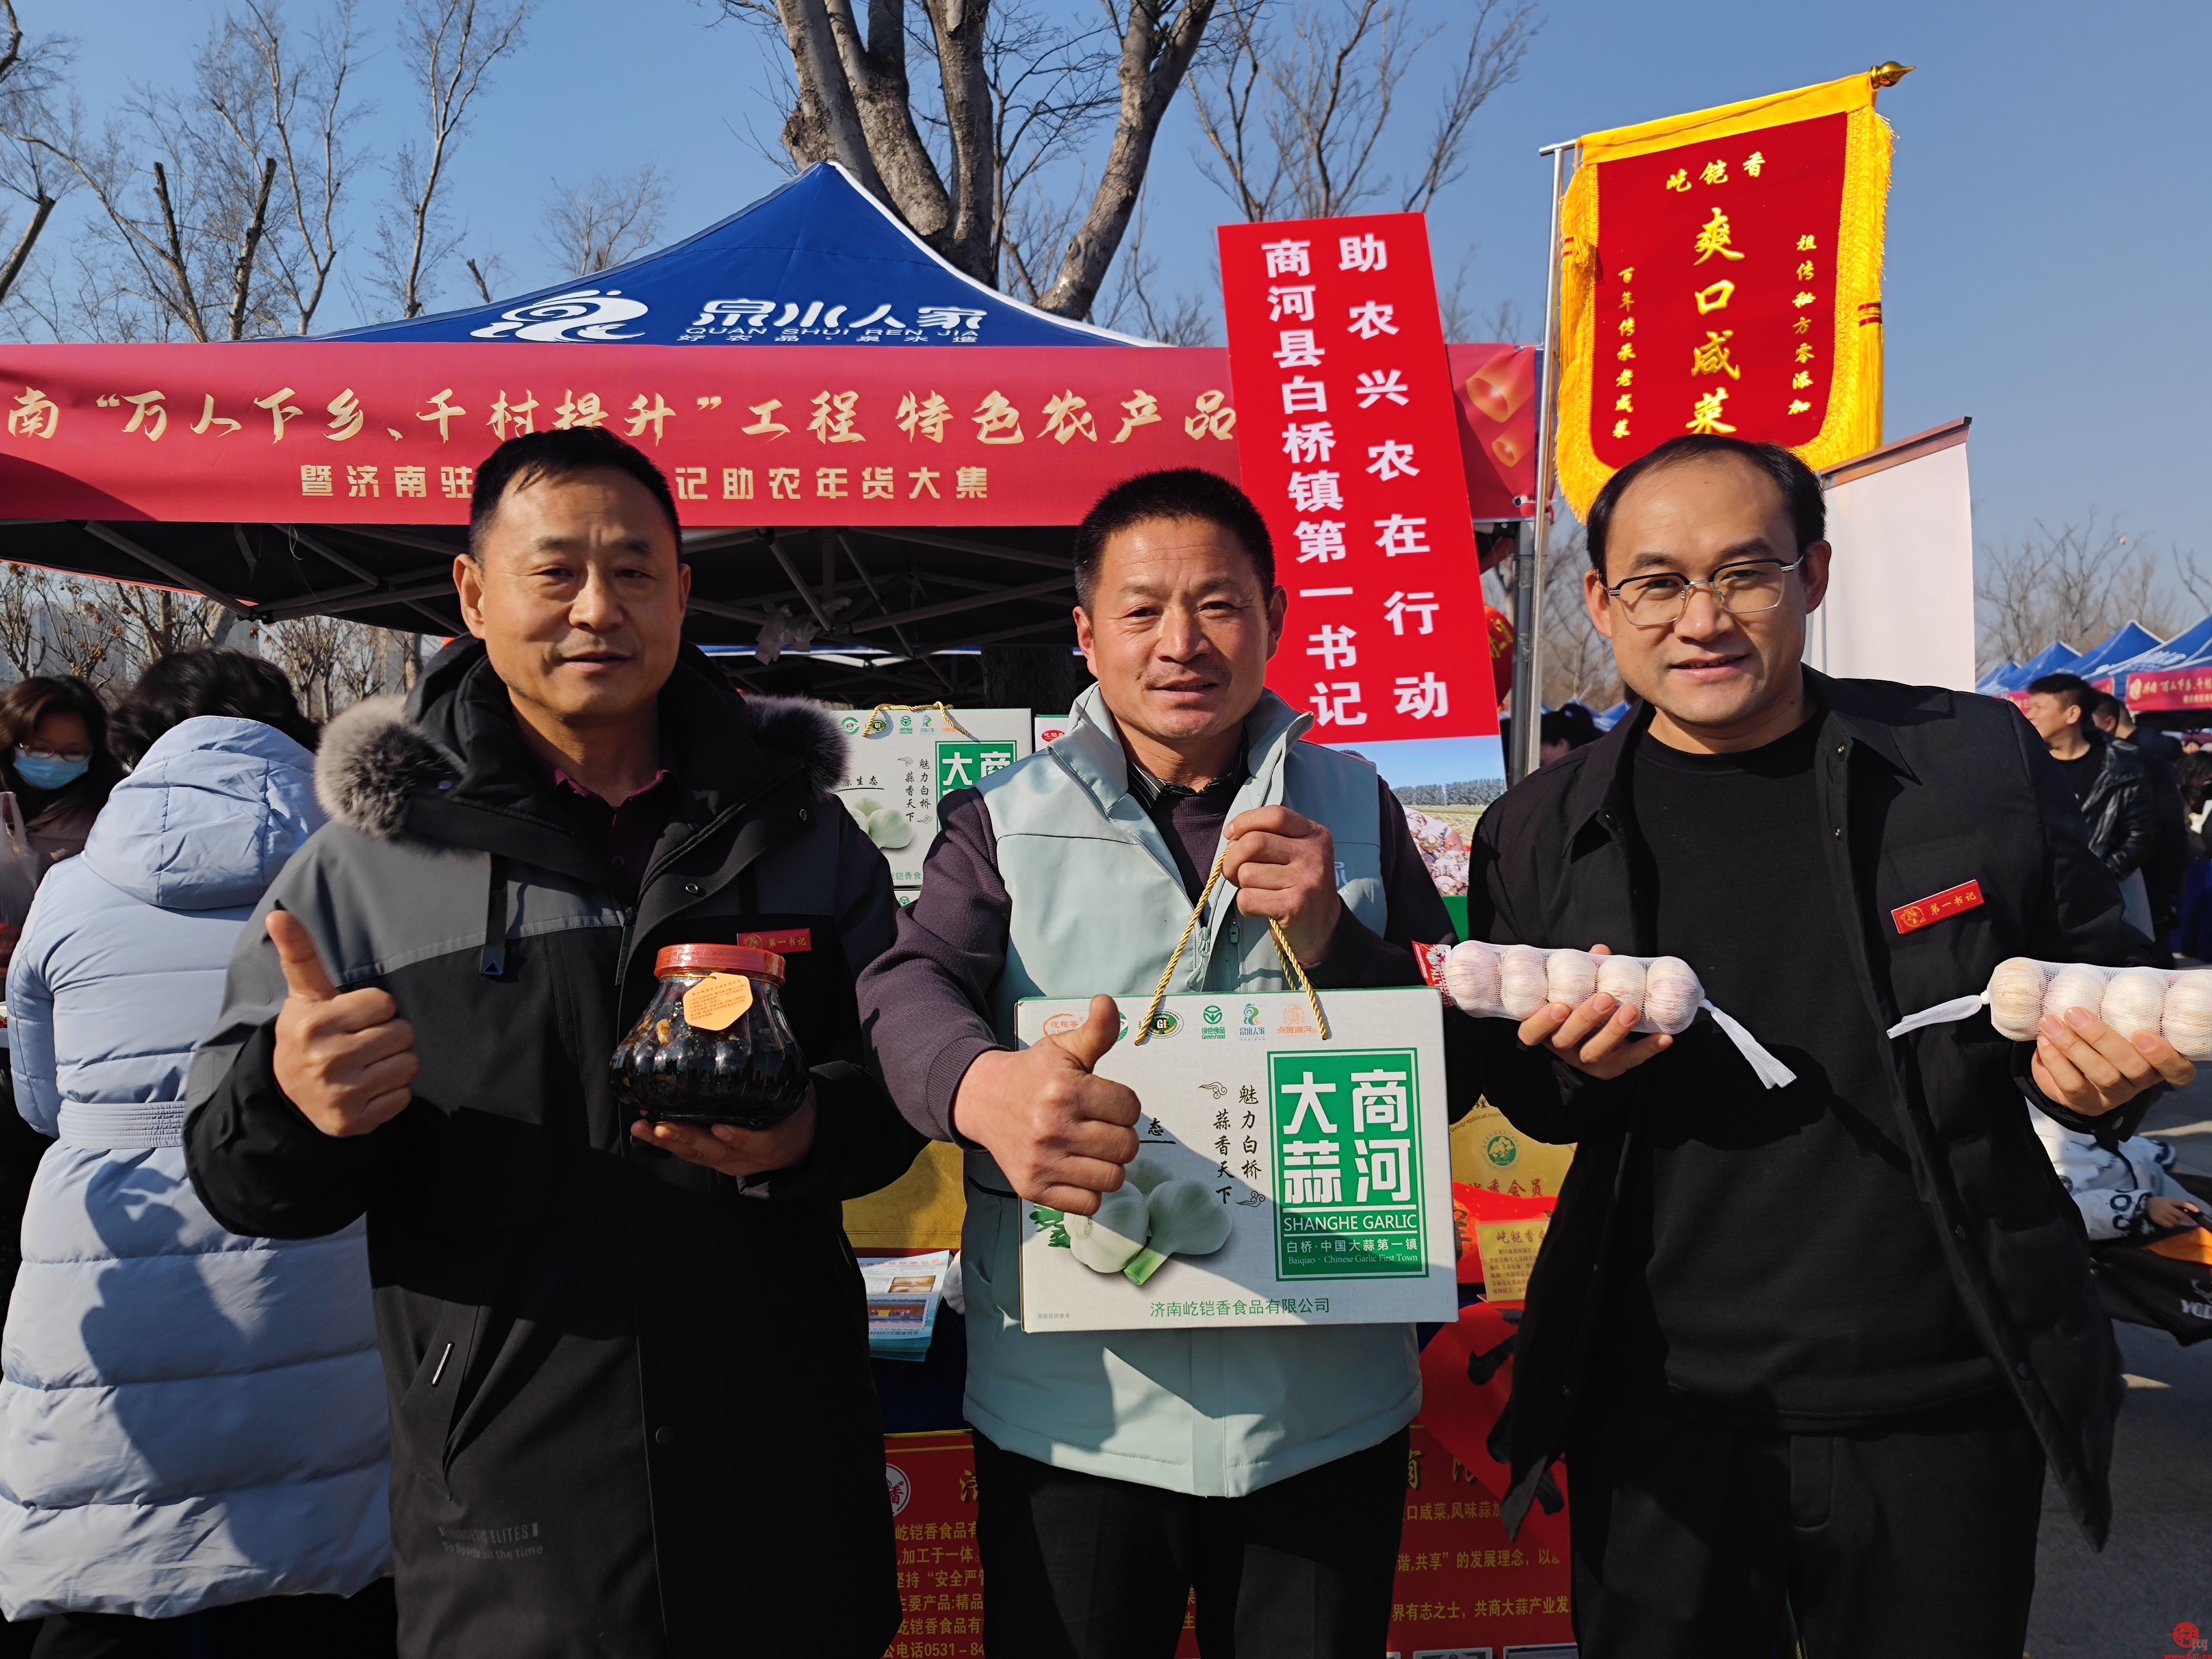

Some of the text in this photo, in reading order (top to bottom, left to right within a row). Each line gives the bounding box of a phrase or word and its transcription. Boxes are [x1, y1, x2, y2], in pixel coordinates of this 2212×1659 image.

[1666, 151, 1766, 193] 屹铠香
[692, 299, 987, 328] 泉水人家
[1789, 234, 1817, 415] 祖传秘方零添加
[782, 328, 849, 336] SHUI
[865, 329, 923, 337] REN
[937, 329, 979, 337] JIA
[1262, 240, 1367, 727] 商河县白桥镇第一书记
[1339, 233, 1449, 720] 助农兴农在行动
[905, 772, 916, 822] 蒜香天下
[919, 759, 931, 809] 魅力白桥
[1930, 892, 1977, 916] 第一书记
[768, 936, 807, 949] 第一书记
[1239, 1027, 1265, 1036] 泉水人家
[1238, 1084, 1262, 1181] 魅力白桥
[1450, 1112, 1487, 1133] Geographical
[1212, 1110, 1233, 1205] 蒜香天下
[1469, 1178, 1542, 1197] 秀会员
[1284, 1214, 1417, 1231] SHANGHE GARLIC
[1289, 1253, 1418, 1266] Baiqiao Chinese Garlic First Town
[1150, 1297, 1330, 1318] 济南屹铠香食品有限公司
